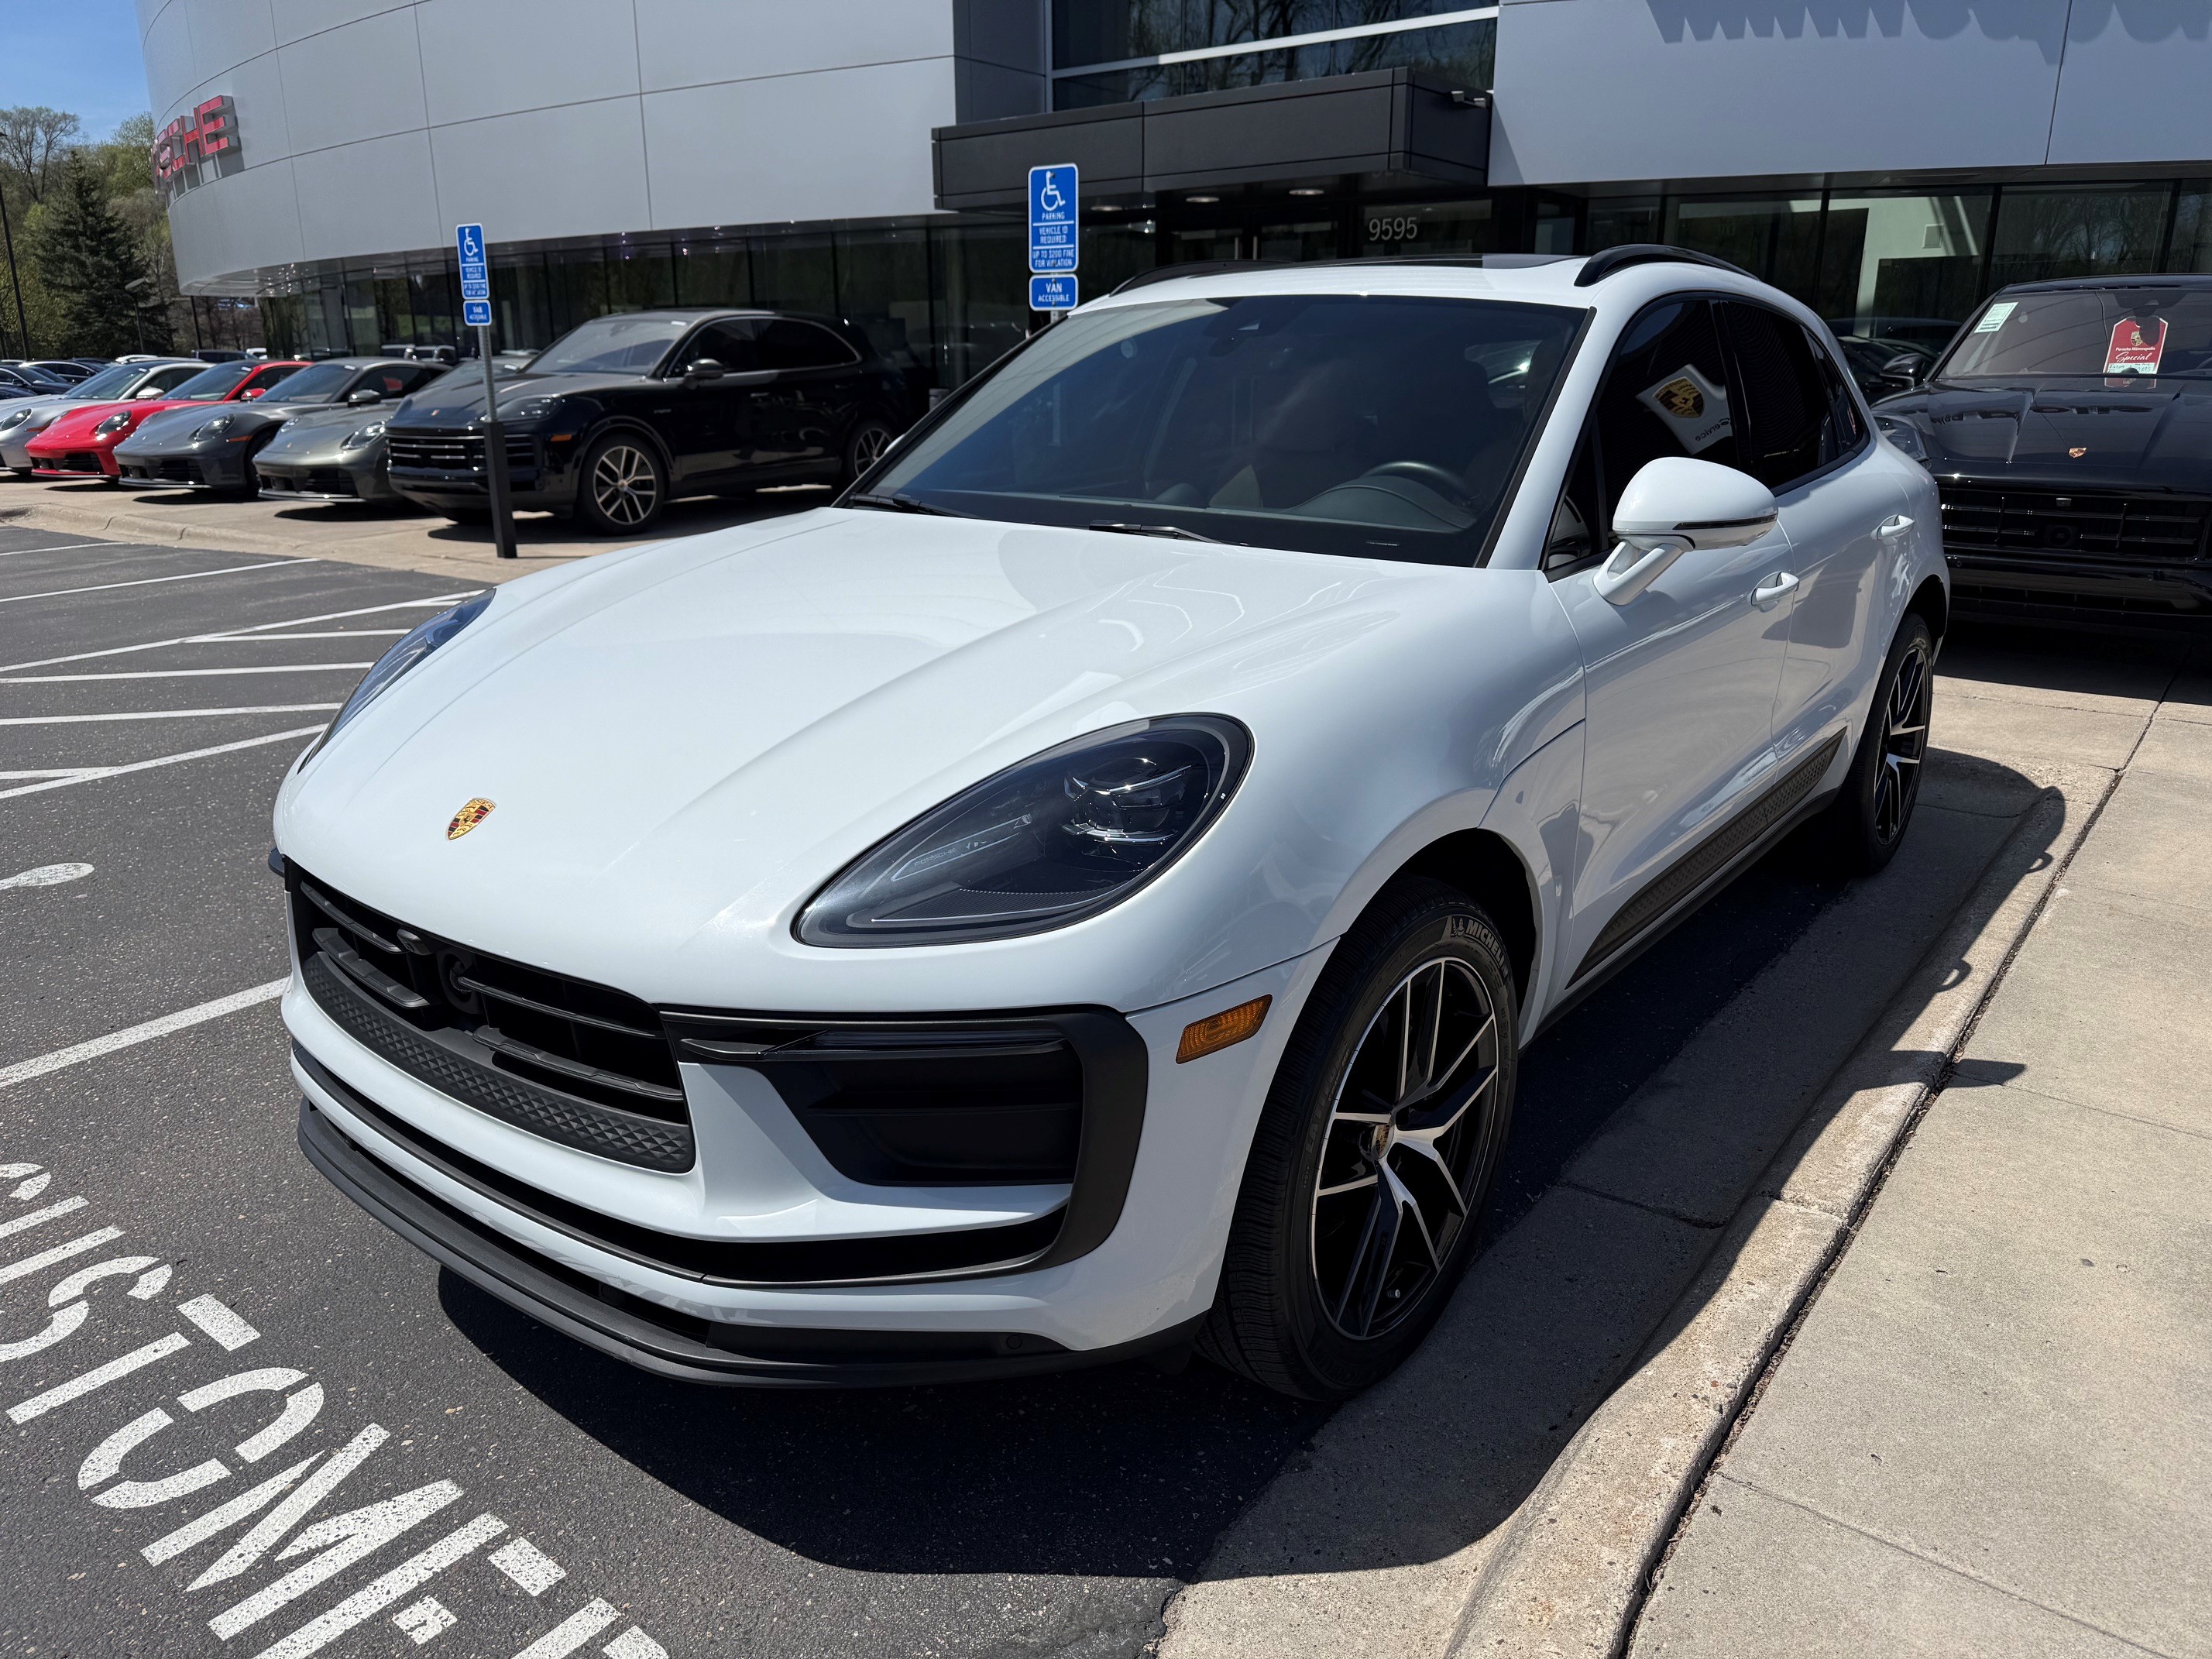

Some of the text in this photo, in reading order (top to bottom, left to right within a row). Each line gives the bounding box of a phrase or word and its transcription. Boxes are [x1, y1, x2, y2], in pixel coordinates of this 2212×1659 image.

[1042, 212, 1065, 221] PARKING
[1039, 225, 1069, 235] VEHICLE ID
[1369, 217, 1418, 242] 9595
[1040, 235, 1067, 244] REQUIRED
[1032, 250, 1040, 259] UP
[1063, 249, 1074, 257] FINE
[1035, 259, 1046, 268] FOR
[1046, 283, 1062, 294] VAN
[1038, 294, 1070, 303] ACCESSIBLE
[2115, 352, 2153, 362] Special
[914, 847, 957, 867] PORSCHE
[1465, 919, 1510, 979] MICHELIN
[0, 1163, 670, 1659] USTOME
